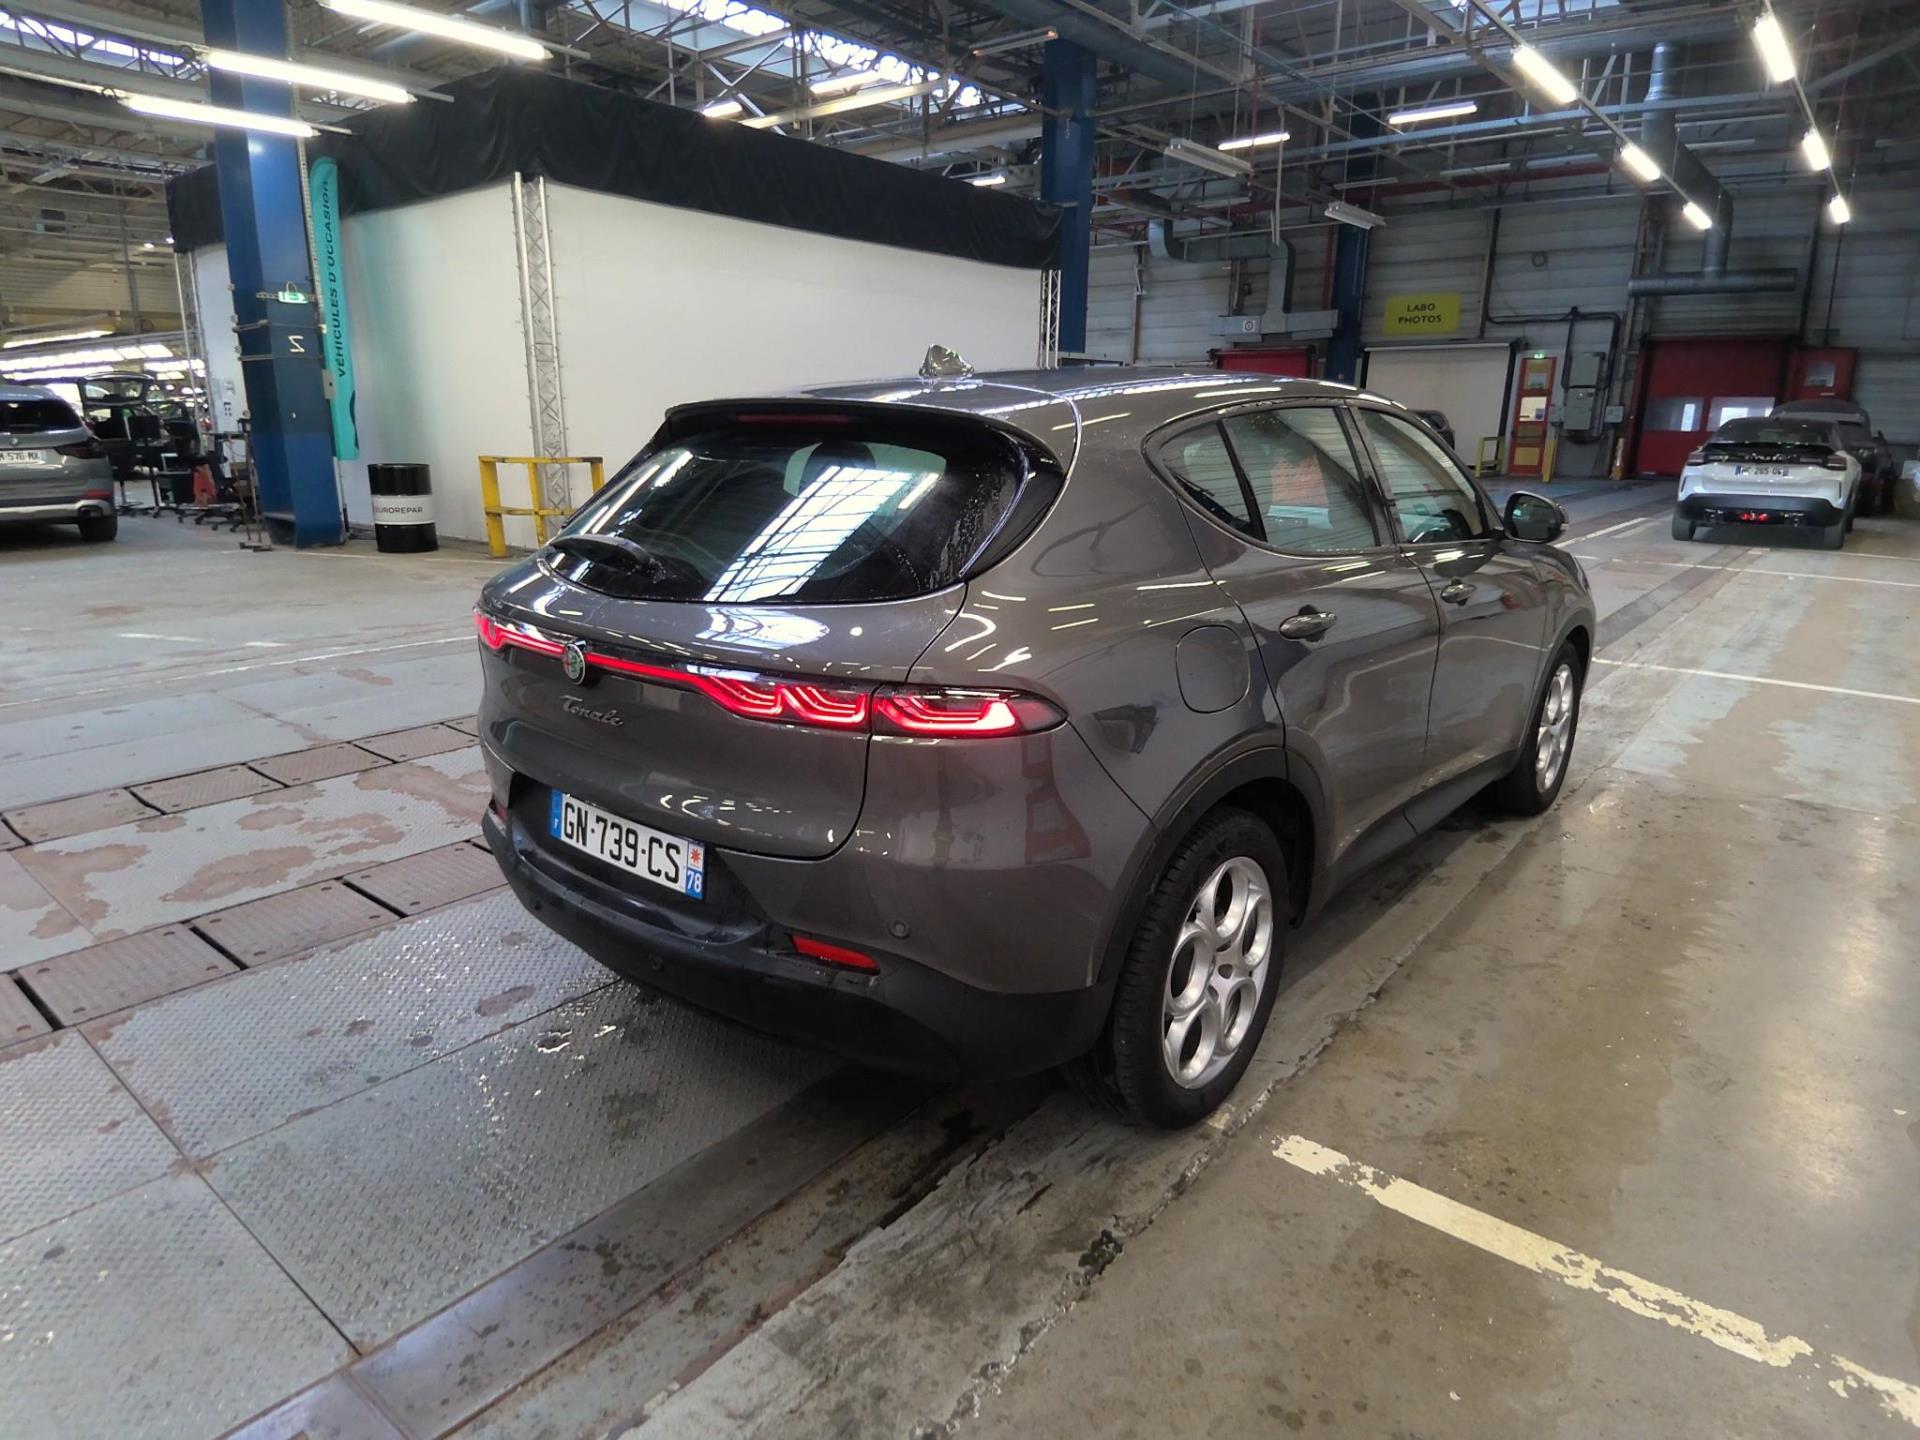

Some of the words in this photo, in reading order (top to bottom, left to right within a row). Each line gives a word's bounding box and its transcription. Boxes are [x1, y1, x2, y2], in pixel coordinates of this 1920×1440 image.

[1407, 303, 1436, 312] LABO
[1398, 314, 1442, 324] PHOTOS
[560, 694, 624, 727] Tonale
[554, 818, 560, 829] F
[563, 801, 681, 884] GN-739-CS
[687, 870, 702, 893] 78
